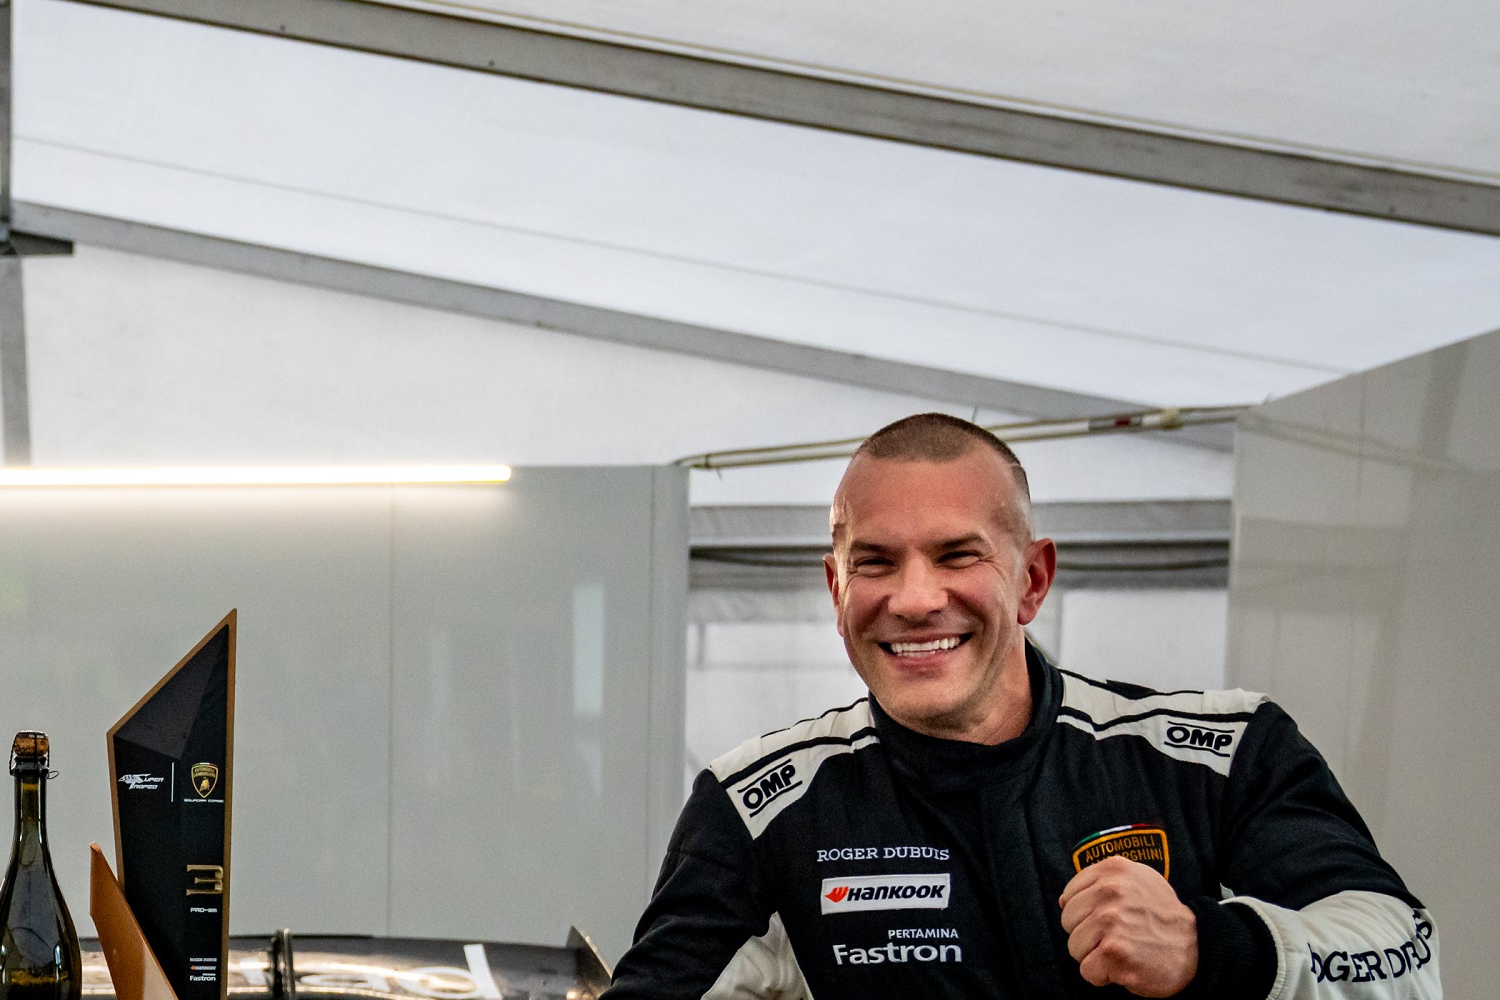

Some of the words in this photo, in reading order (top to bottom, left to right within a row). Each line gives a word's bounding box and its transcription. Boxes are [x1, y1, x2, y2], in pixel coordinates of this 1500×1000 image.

[1167, 726, 1233, 751] OMP
[743, 764, 796, 809] OMP
[817, 848, 878, 862] ROGER
[883, 847, 950, 861] DUBUIS
[1085, 835, 1155, 863] AUTOMOBILI
[186, 865, 223, 896] 3
[888, 929, 959, 939] PERTAMINA
[833, 942, 962, 965] Fastron
